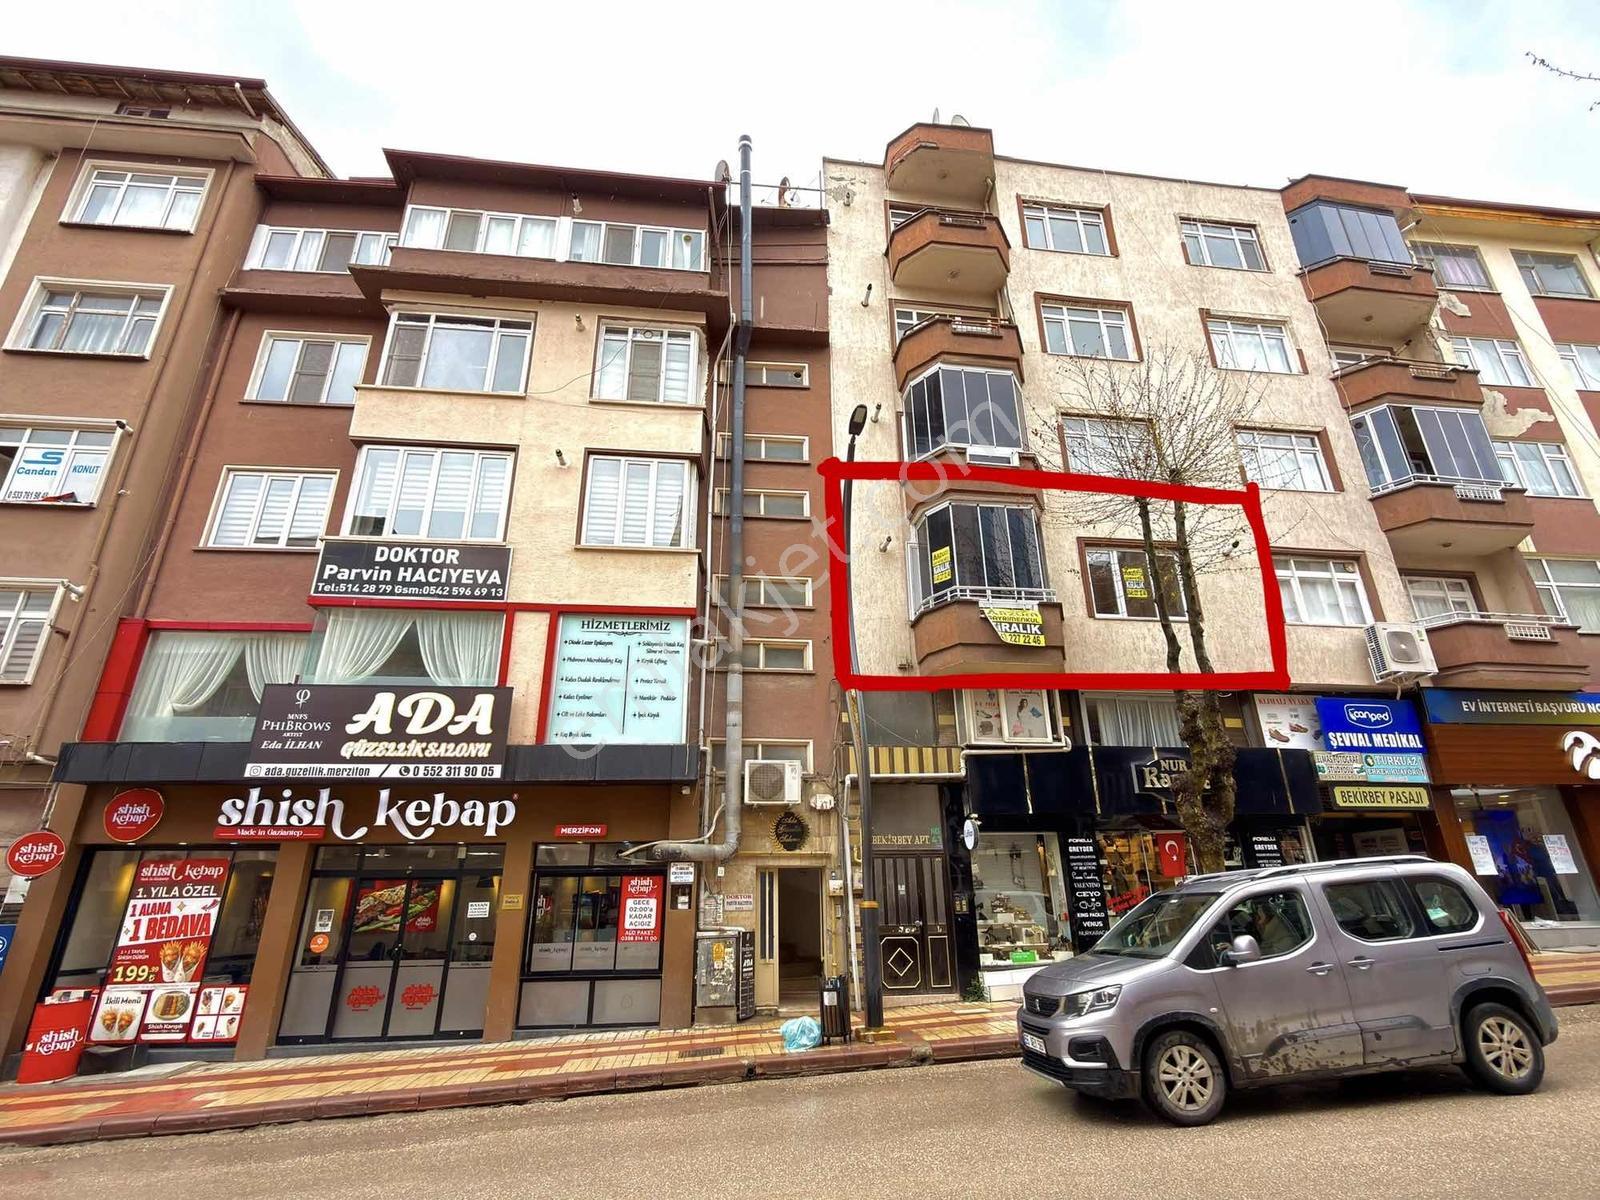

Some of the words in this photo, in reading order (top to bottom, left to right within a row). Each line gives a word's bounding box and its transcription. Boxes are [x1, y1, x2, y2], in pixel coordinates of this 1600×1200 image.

[17, 467, 57, 476] Candan
[72, 465, 100, 474] KONUT
[374, 546, 460, 564] DOKTOR
[323, 564, 392, 581] Parvin
[397, 566, 502, 584] HACIYEVA
[317, 582, 360, 592] Tel:514
[362, 584, 376, 593] 28
[378, 584, 392, 594] 79
[394, 584, 450, 595] Gsm:0542
[452, 586, 472, 596] 596
[474, 587, 489, 596] 69
[491, 588, 504, 596] 13
[581, 618, 670, 631] HİZMETLERİMİZ
[1023, 634, 1031, 644] 22
[345, 692, 495, 735] ADA
[1462, 701, 1476, 712] EV
[1478, 699, 1535, 712] İNTERNETİ
[1536, 702, 1585, 716] BAŞVURU
[261, 740, 282, 750] Eda
[284, 738, 322, 750] İLHAN
[1328, 732, 1372, 748] ŞEVVAL
[1373, 731, 1423, 748] MEDİKAL
[340, 739, 425, 758] GÜZELLİK
[424, 742, 492, 758] SALONU
[412, 766, 420, 776] 0
[422, 766, 442, 776] 552
[446, 766, 461, 776] 311
[464, 766, 478, 776] 90
[480, 766, 494, 776] 05
[1160, 760, 1188, 772] NUR
[1340, 788, 1386, 804] BEKİRBEY
[1390, 791, 1424, 804] PASAJI
[118, 804, 156, 818] shish
[218, 787, 368, 840] shish
[374, 788, 516, 840] kebap
[112, 814, 148, 825] kebap
[872, 833, 912, 844] BEKİRBEY
[20, 843, 64, 856] shish
[15, 852, 55, 864] kebap
[141, 864, 183, 880] shish
[185, 865, 224, 880] kebap
[136, 888, 147, 898] 1.
[150, 887, 179, 898] YILA
[182, 884, 218, 896] ÖZEL
[130, 904, 138, 917] 1
[140, 902, 172, 916] ALANA
[129, 919, 142, 942] 1
[145, 913, 211, 940] BEDAVA
[113, 965, 148, 982] 199
[120, 996, 142, 1004] Menü
[41, 1028, 84, 1042] shish
[36, 1039, 76, 1056] kebap
